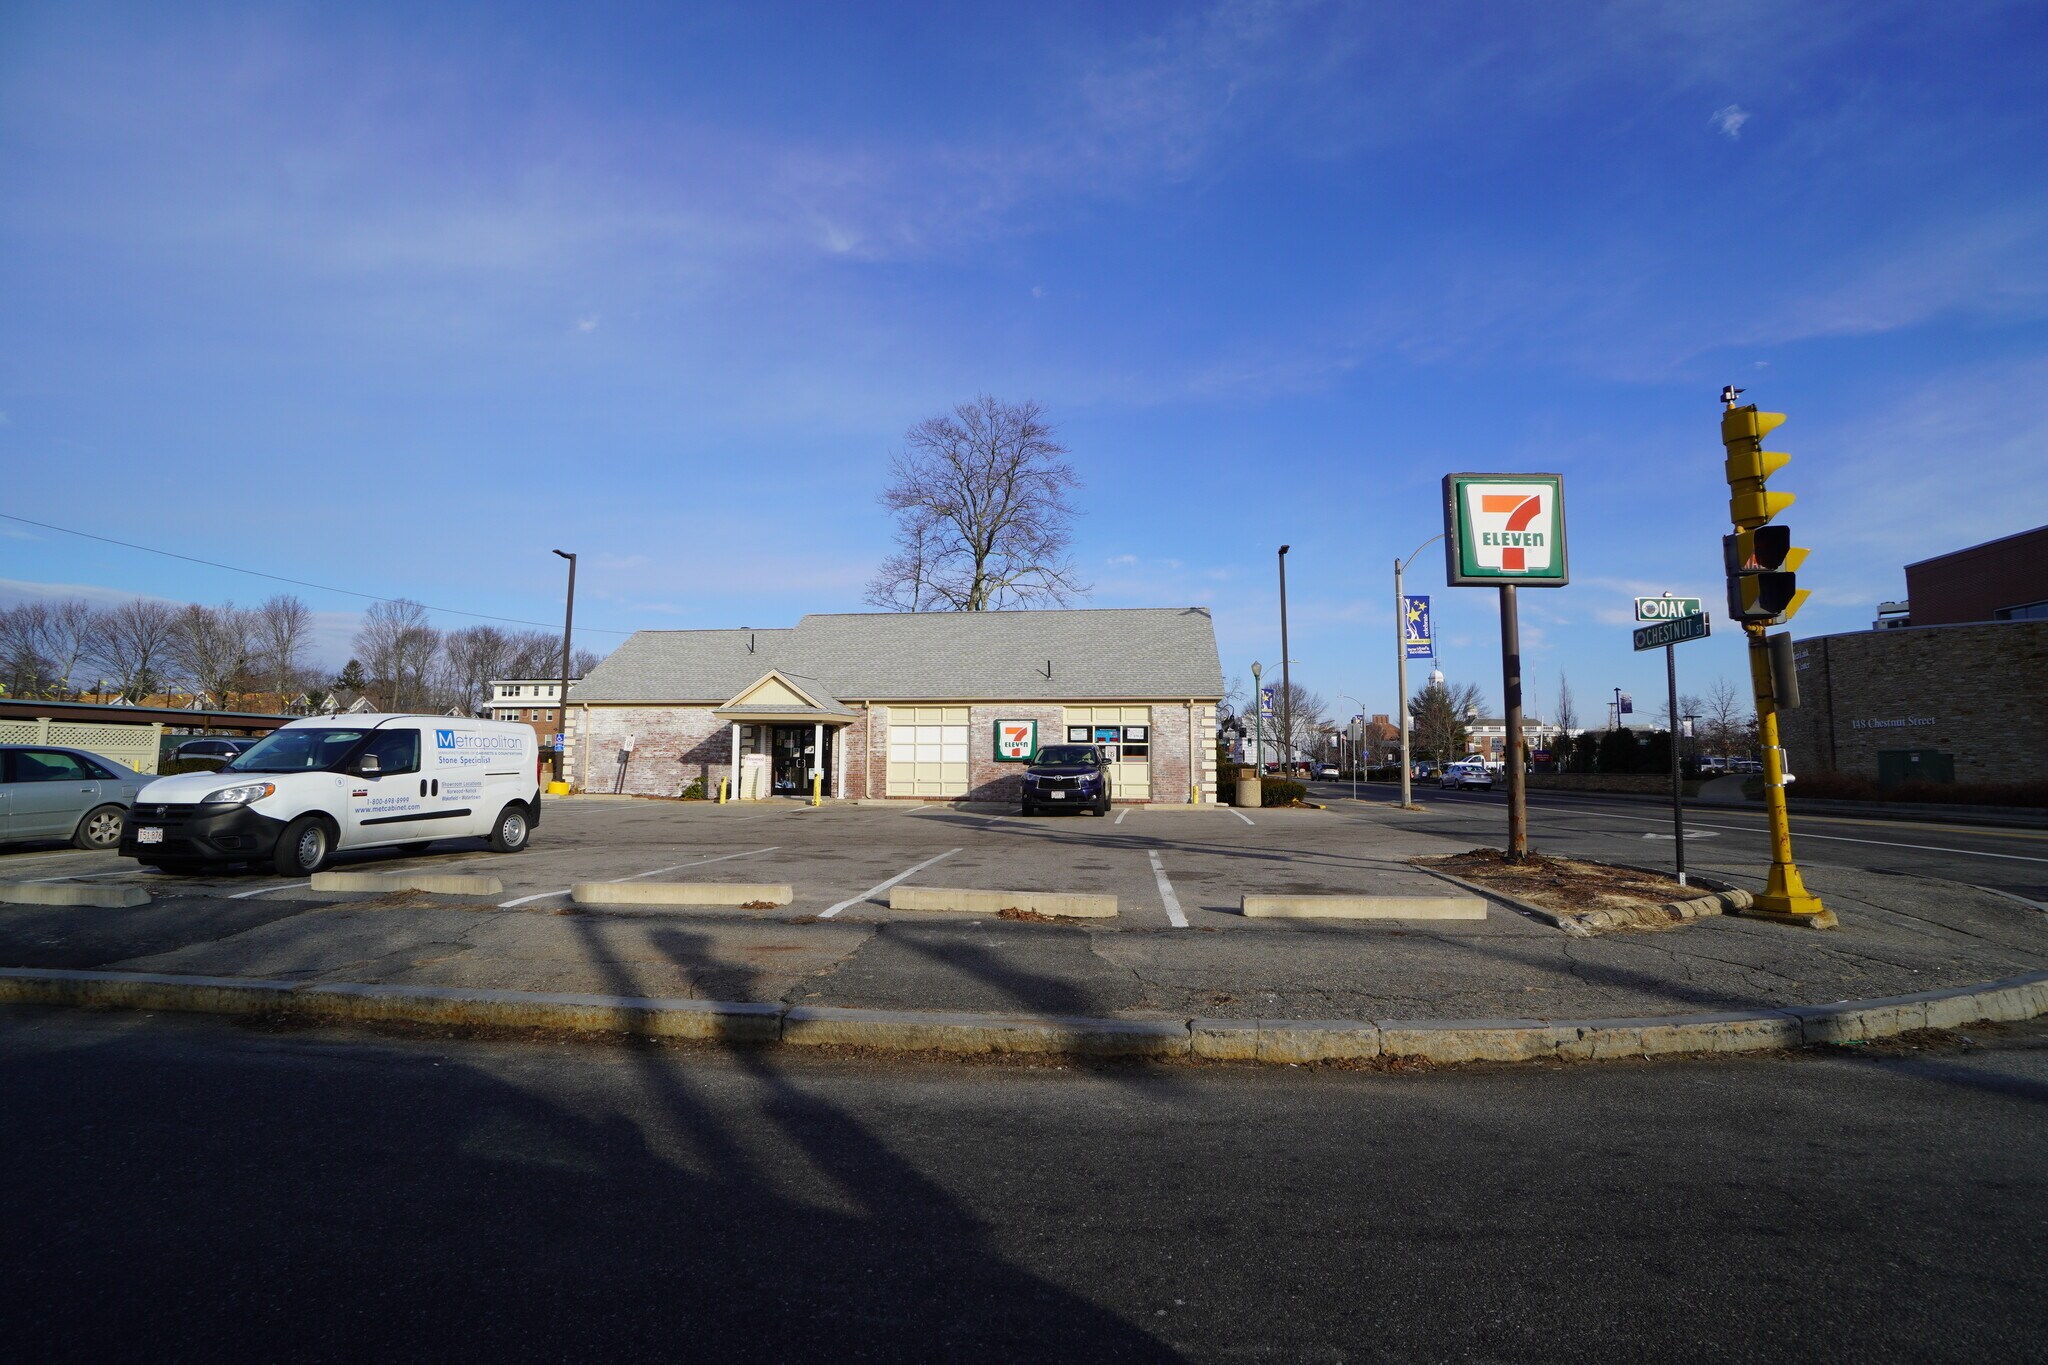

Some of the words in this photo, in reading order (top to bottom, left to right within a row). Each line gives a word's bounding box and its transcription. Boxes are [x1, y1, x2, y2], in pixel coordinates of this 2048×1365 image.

[1482, 495, 1541, 569] 7
[1660, 600, 1686, 617] OAK
[1646, 618, 1693, 646] CHESTNUT
[1695, 624, 1703, 634] ST
[1852, 719, 1867, 729] 148
[1868, 717, 1906, 729] Chestnut
[1908, 714, 1936, 726] Street
[437, 731, 523, 749] Metropolitan
[1005, 727, 1027, 756] 7
[438, 756, 458, 764] Stone
[460, 755, 491, 765] Specialist
[355, 804, 420, 813] www.metcabinet.com
[367, 797, 410, 805] 1-800-698-8999
